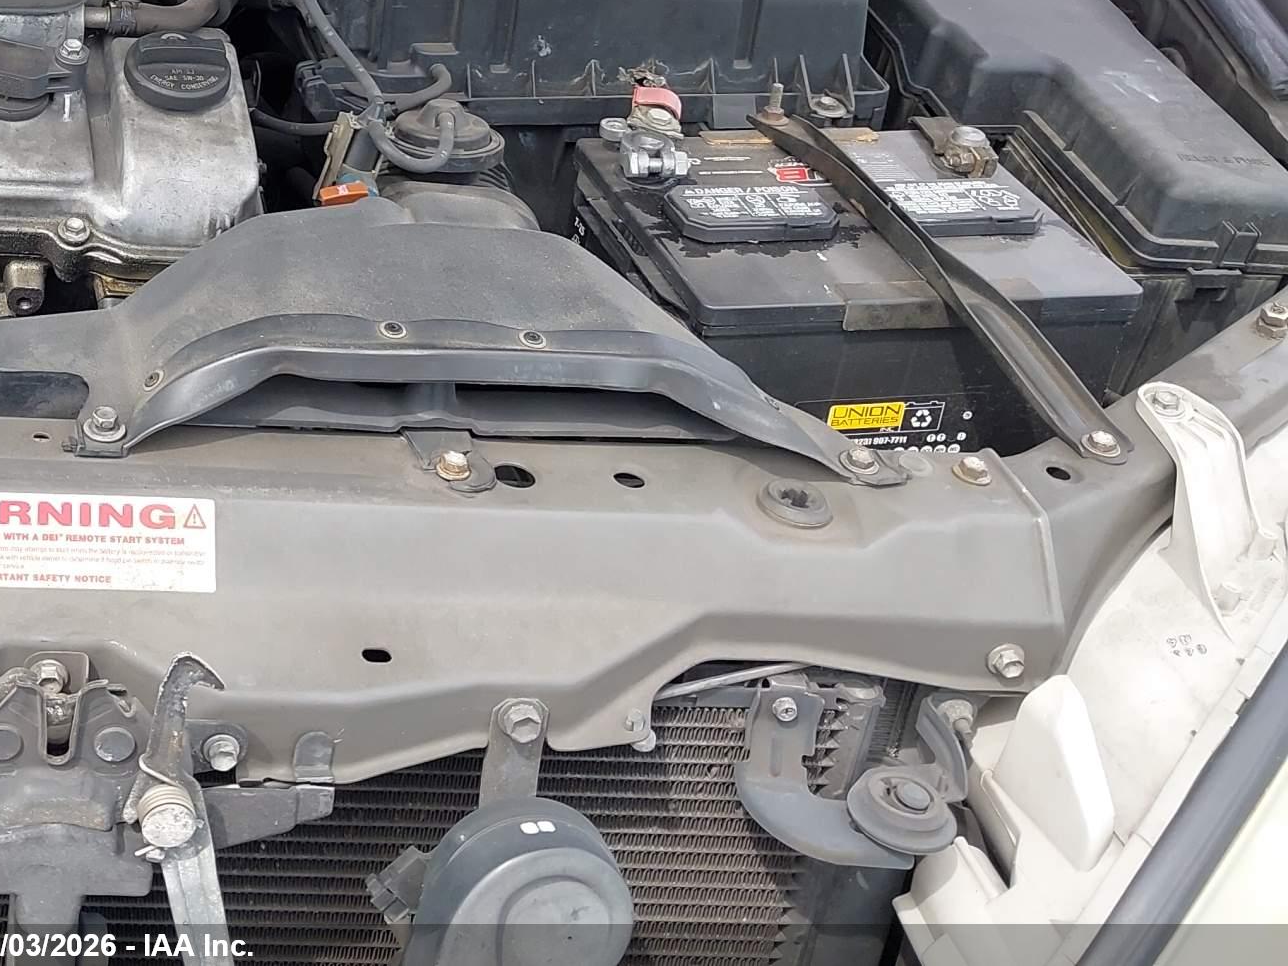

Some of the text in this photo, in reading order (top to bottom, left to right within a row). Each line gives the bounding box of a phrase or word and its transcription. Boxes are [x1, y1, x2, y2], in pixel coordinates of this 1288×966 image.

[694, 186, 743, 195] DANGER
[832, 404, 902, 419] UNION
[830, 416, 899, 427] BATTERIES
[3, 532, 30, 541] WITH
[31, 533, 40, 542] A
[65, 534, 107, 543] REMOTE
[109, 535, 143, 544] START
[144, 536, 186, 546] SYSTEM
[32, 573, 71, 583] SAFETY
[72, 574, 112, 584] NOTICE
